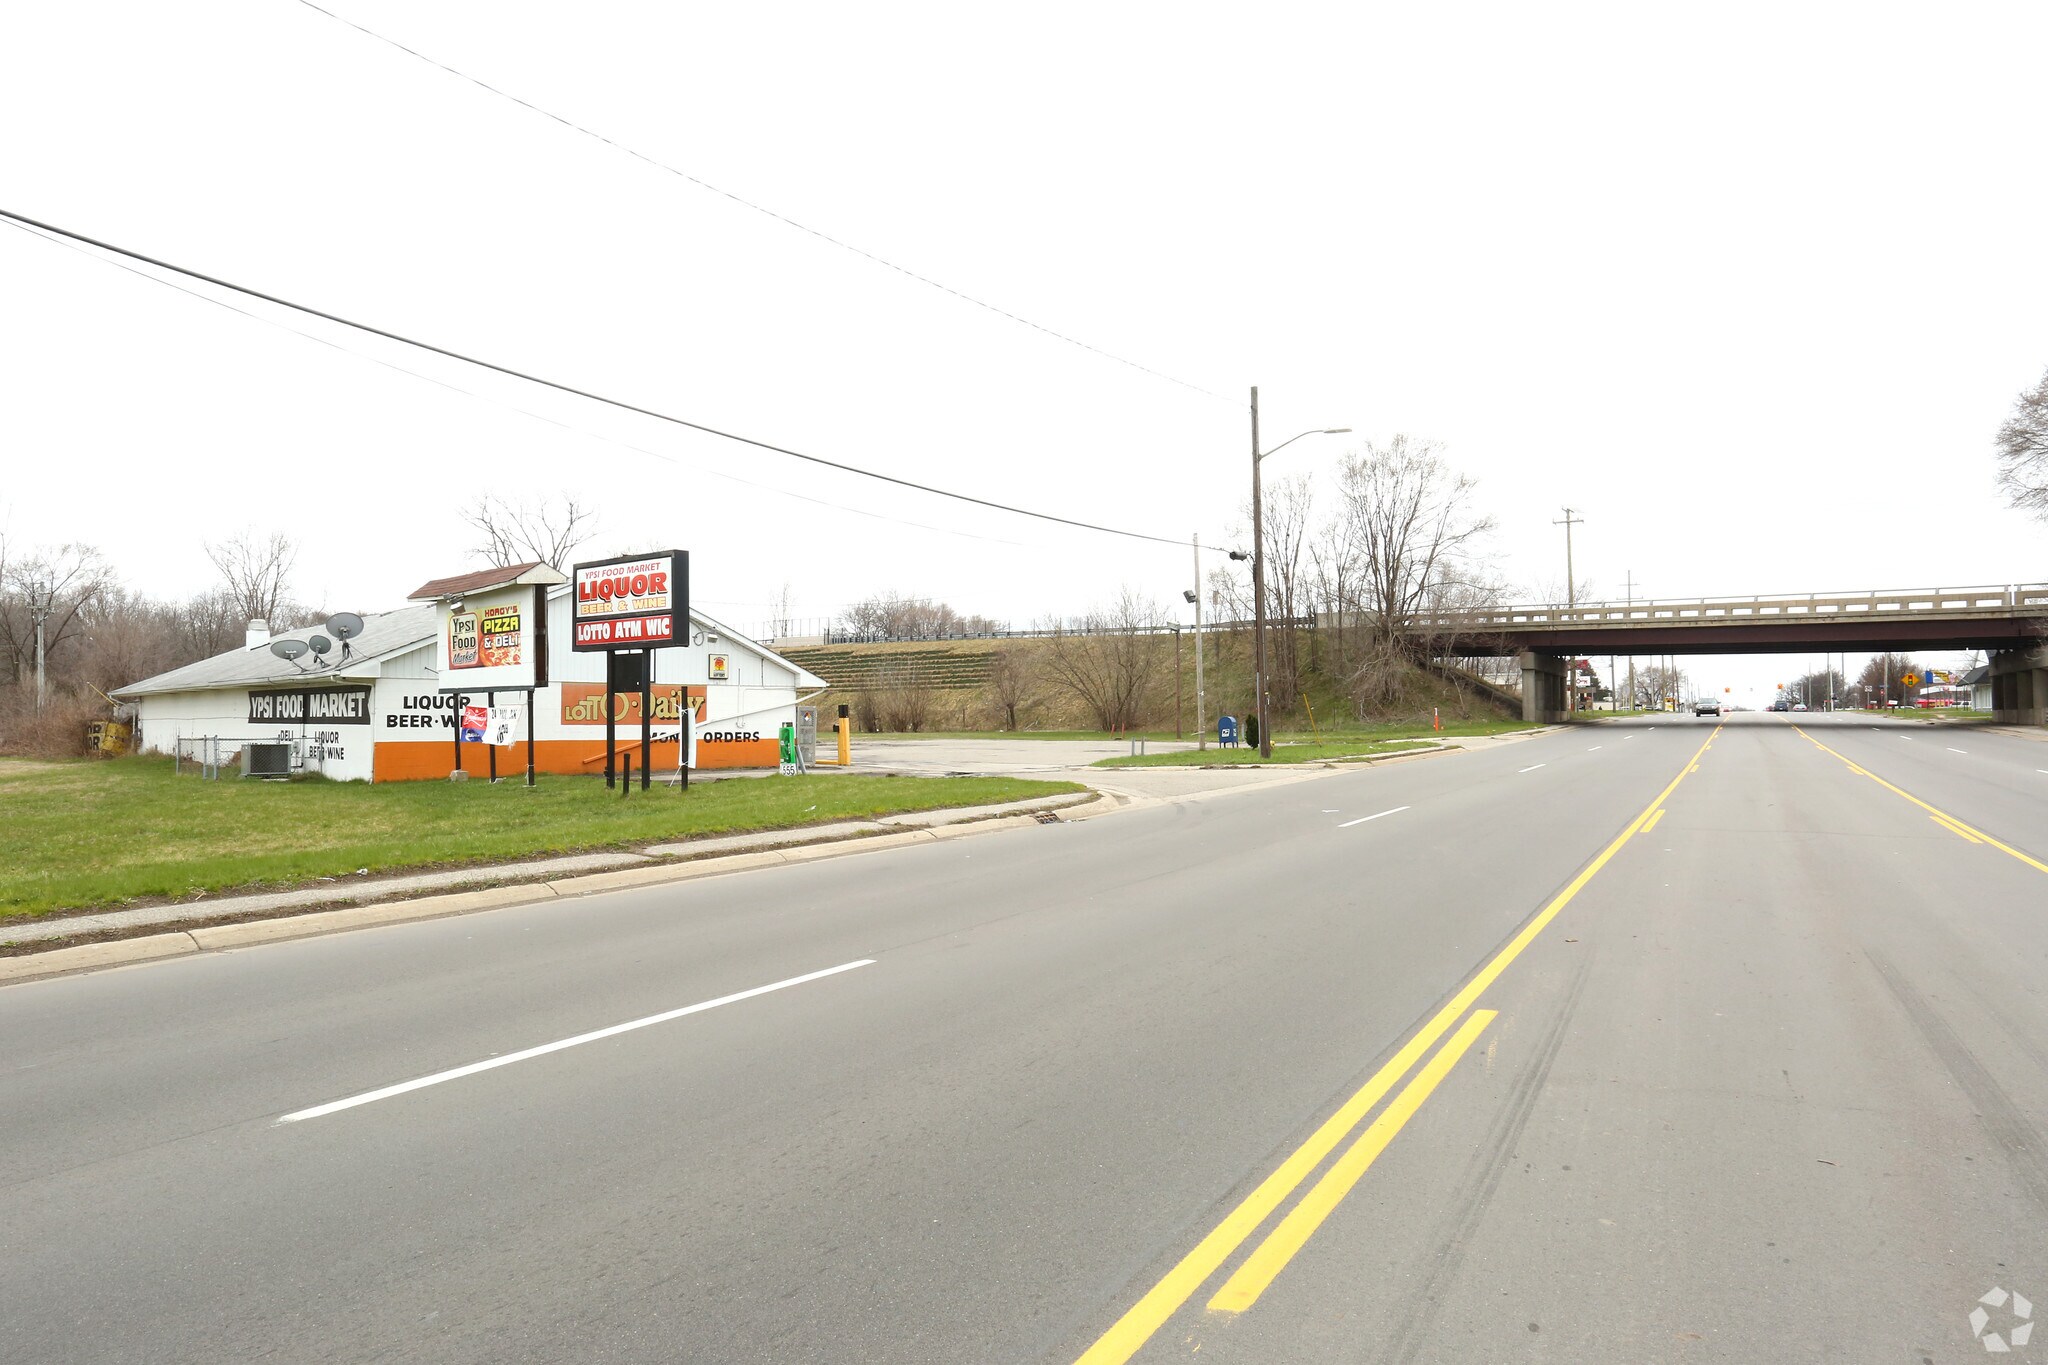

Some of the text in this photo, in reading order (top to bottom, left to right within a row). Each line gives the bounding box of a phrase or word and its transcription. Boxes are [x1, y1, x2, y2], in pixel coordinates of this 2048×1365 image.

[585, 562, 661, 579] YPSI FOOD MARKET
[579, 572, 668, 602] LIQUOR
[581, 597, 666, 615] BEER & WINE
[483, 616, 519, 634] PIZZA
[578, 618, 670, 641] LOTTO ATM WIC
[484, 635, 518, 649] & DELI
[251, 696, 273, 718] YPSI
[309, 692, 366, 717] MARKET
[280, 730, 294, 742] DELI
[314, 731, 340, 744] LIQUOR
[703, 731, 760, 743] ORDERS
